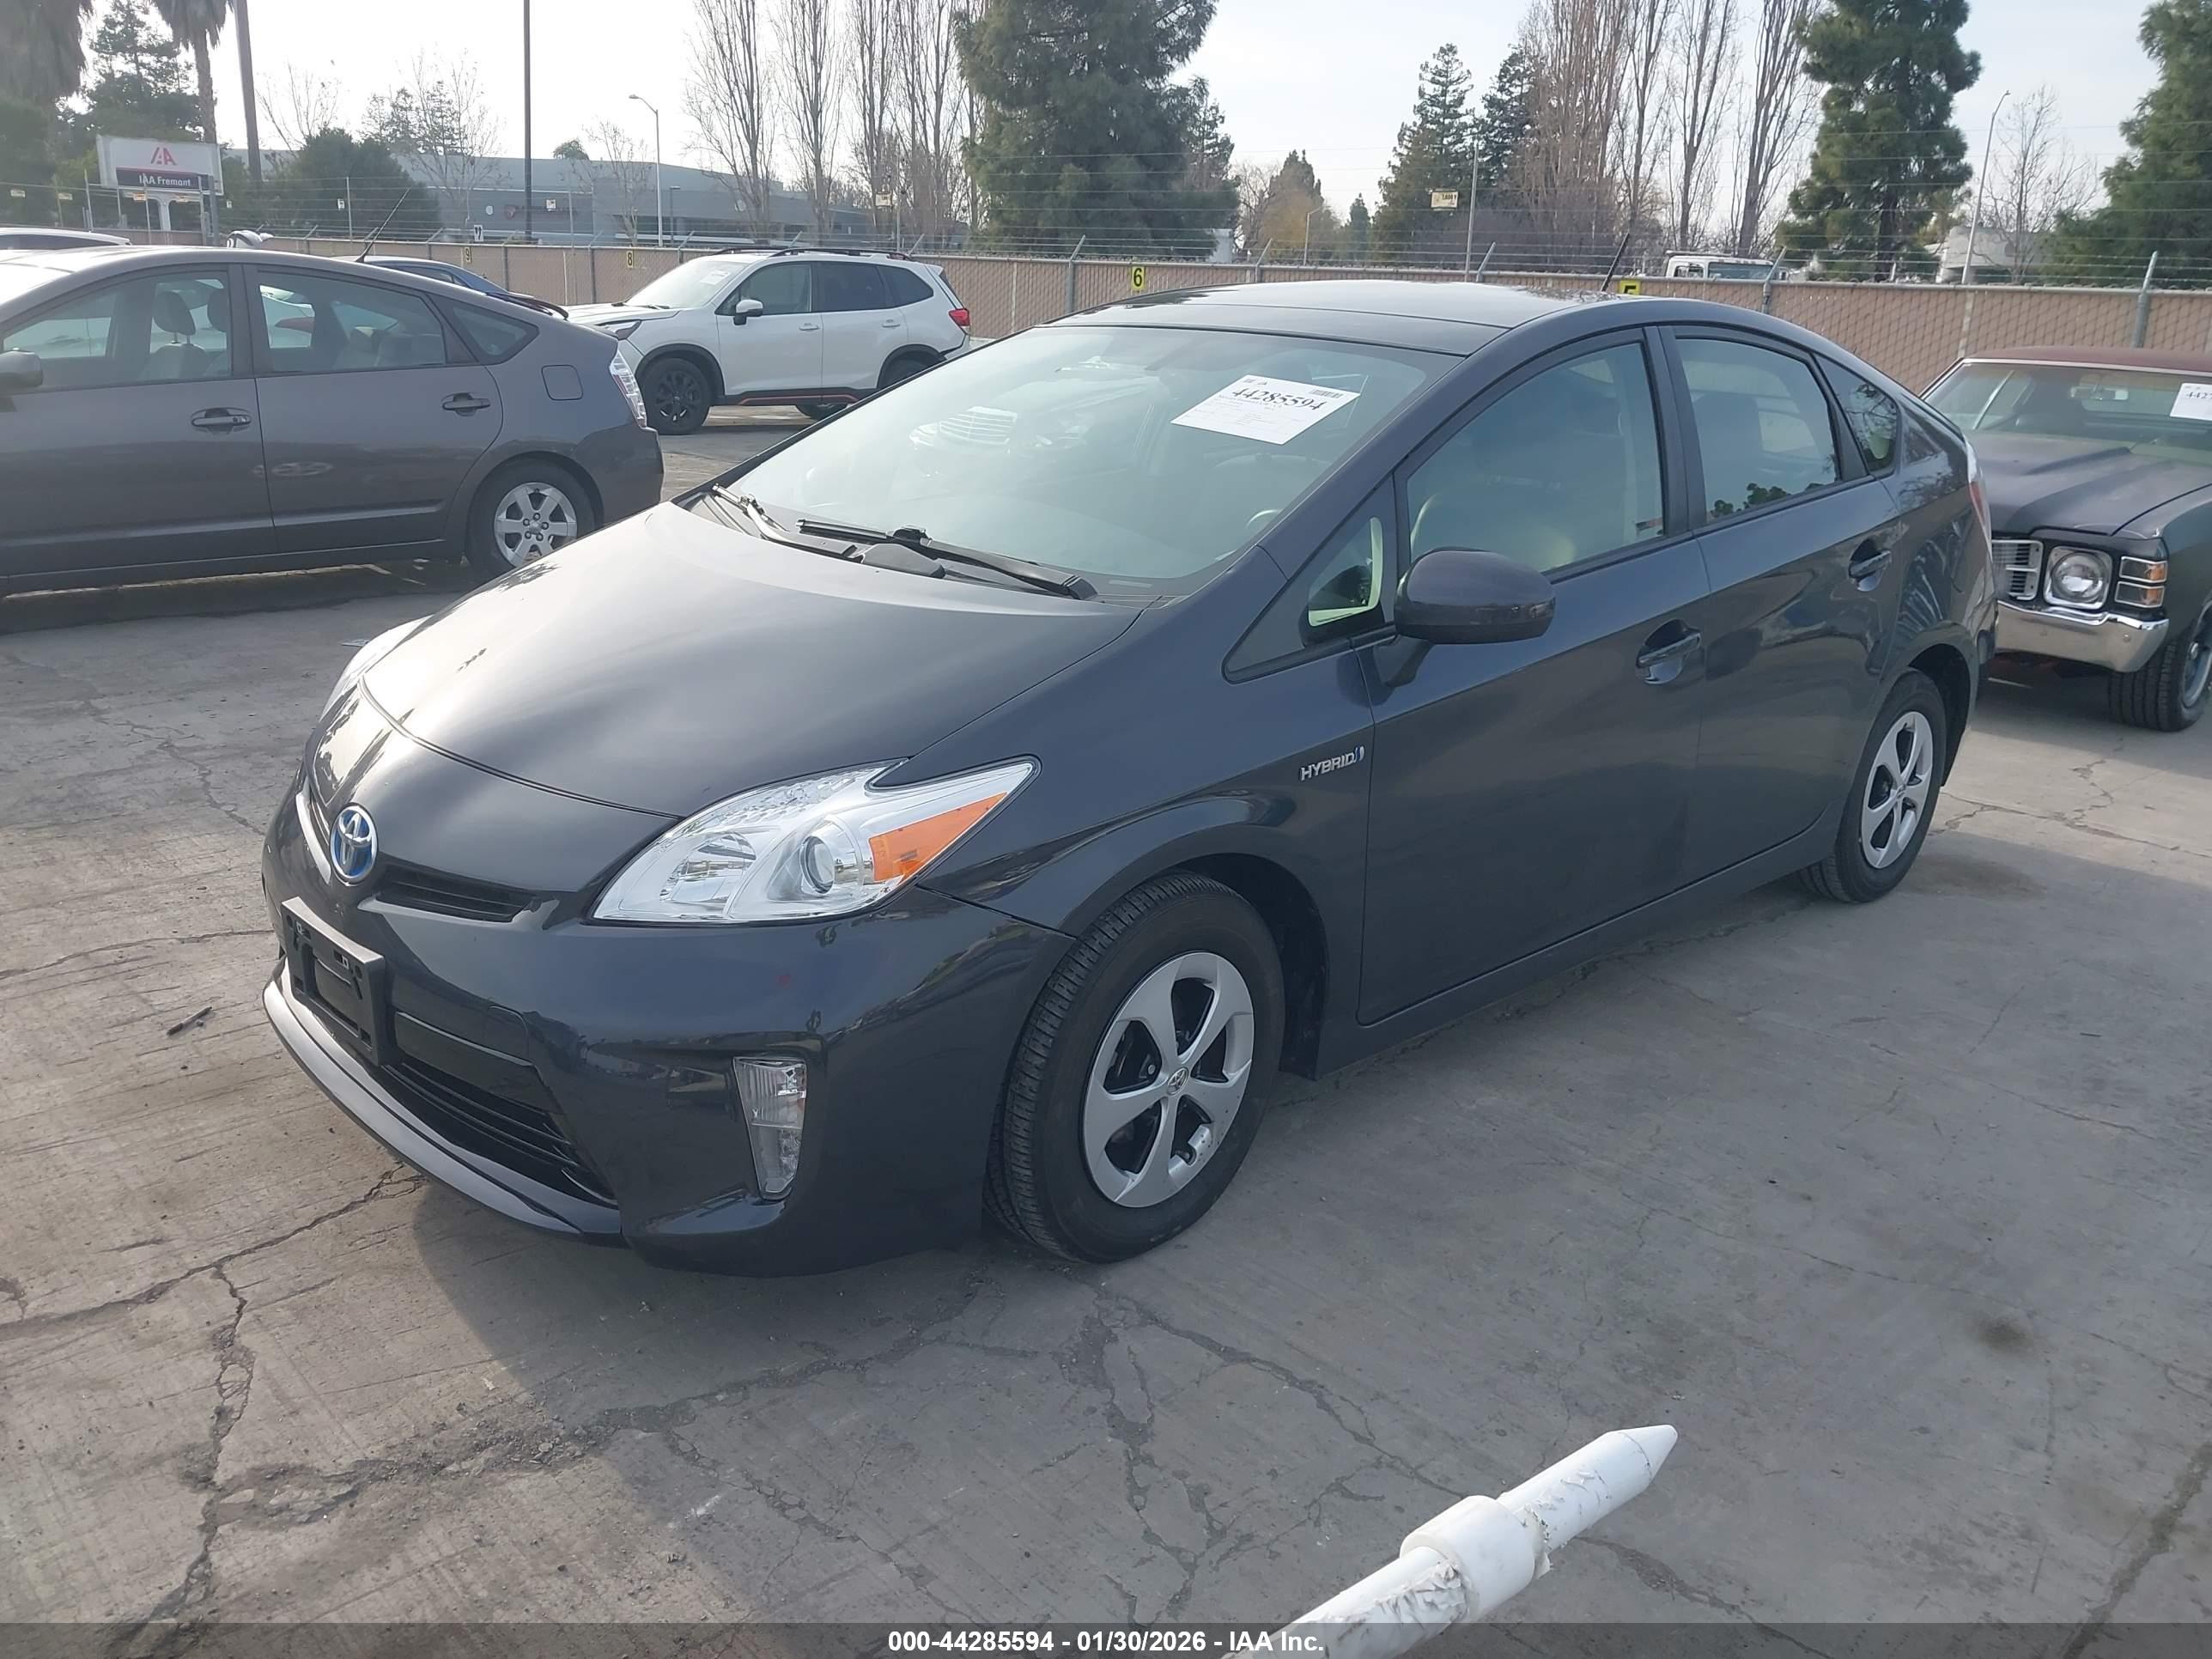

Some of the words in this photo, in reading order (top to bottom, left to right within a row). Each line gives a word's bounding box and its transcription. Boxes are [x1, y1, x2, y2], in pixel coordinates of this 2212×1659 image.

[138, 173, 156, 185] IAA
[157, 176, 191, 186] Fremont
[627, 252, 633, 266] 8
[1133, 267, 1143, 288] 6
[1231, 387, 1328, 410] 44285594
[1301, 751, 1356, 781] HYBRID
